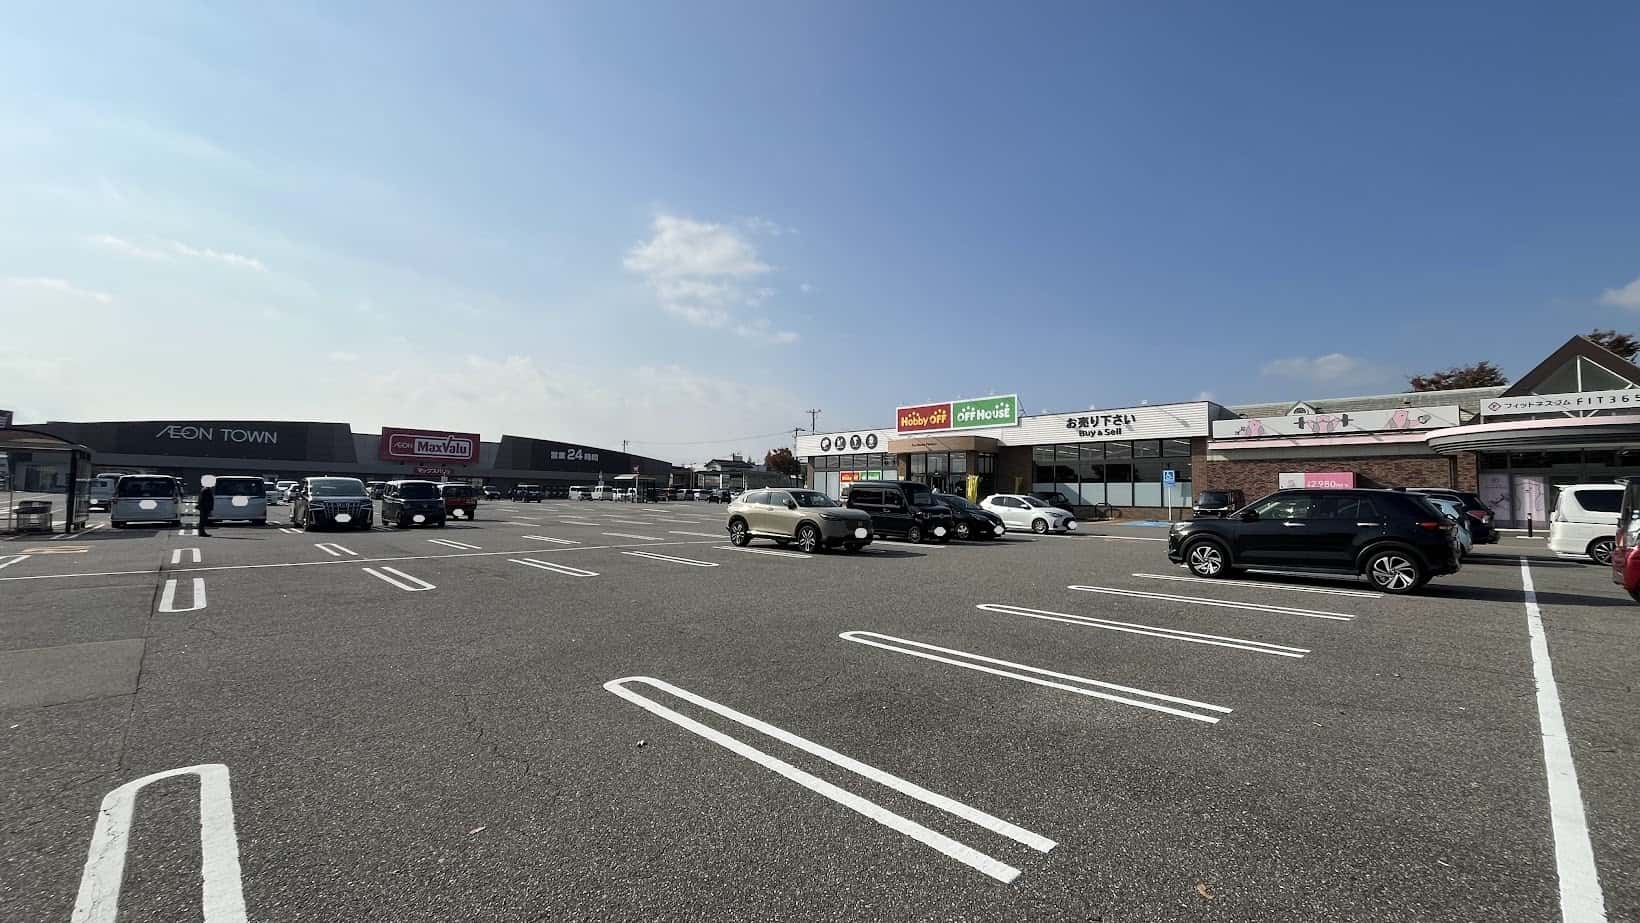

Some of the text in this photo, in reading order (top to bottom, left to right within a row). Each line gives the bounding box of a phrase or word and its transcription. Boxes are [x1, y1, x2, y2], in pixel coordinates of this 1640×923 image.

[1066, 414, 1136, 429] お売り下さい
[220, 428, 277, 444] TOWN
[1079, 430, 1096, 438] Buy
[1104, 428, 1122, 436] Sell
[417, 438, 467, 454] MaxValu
